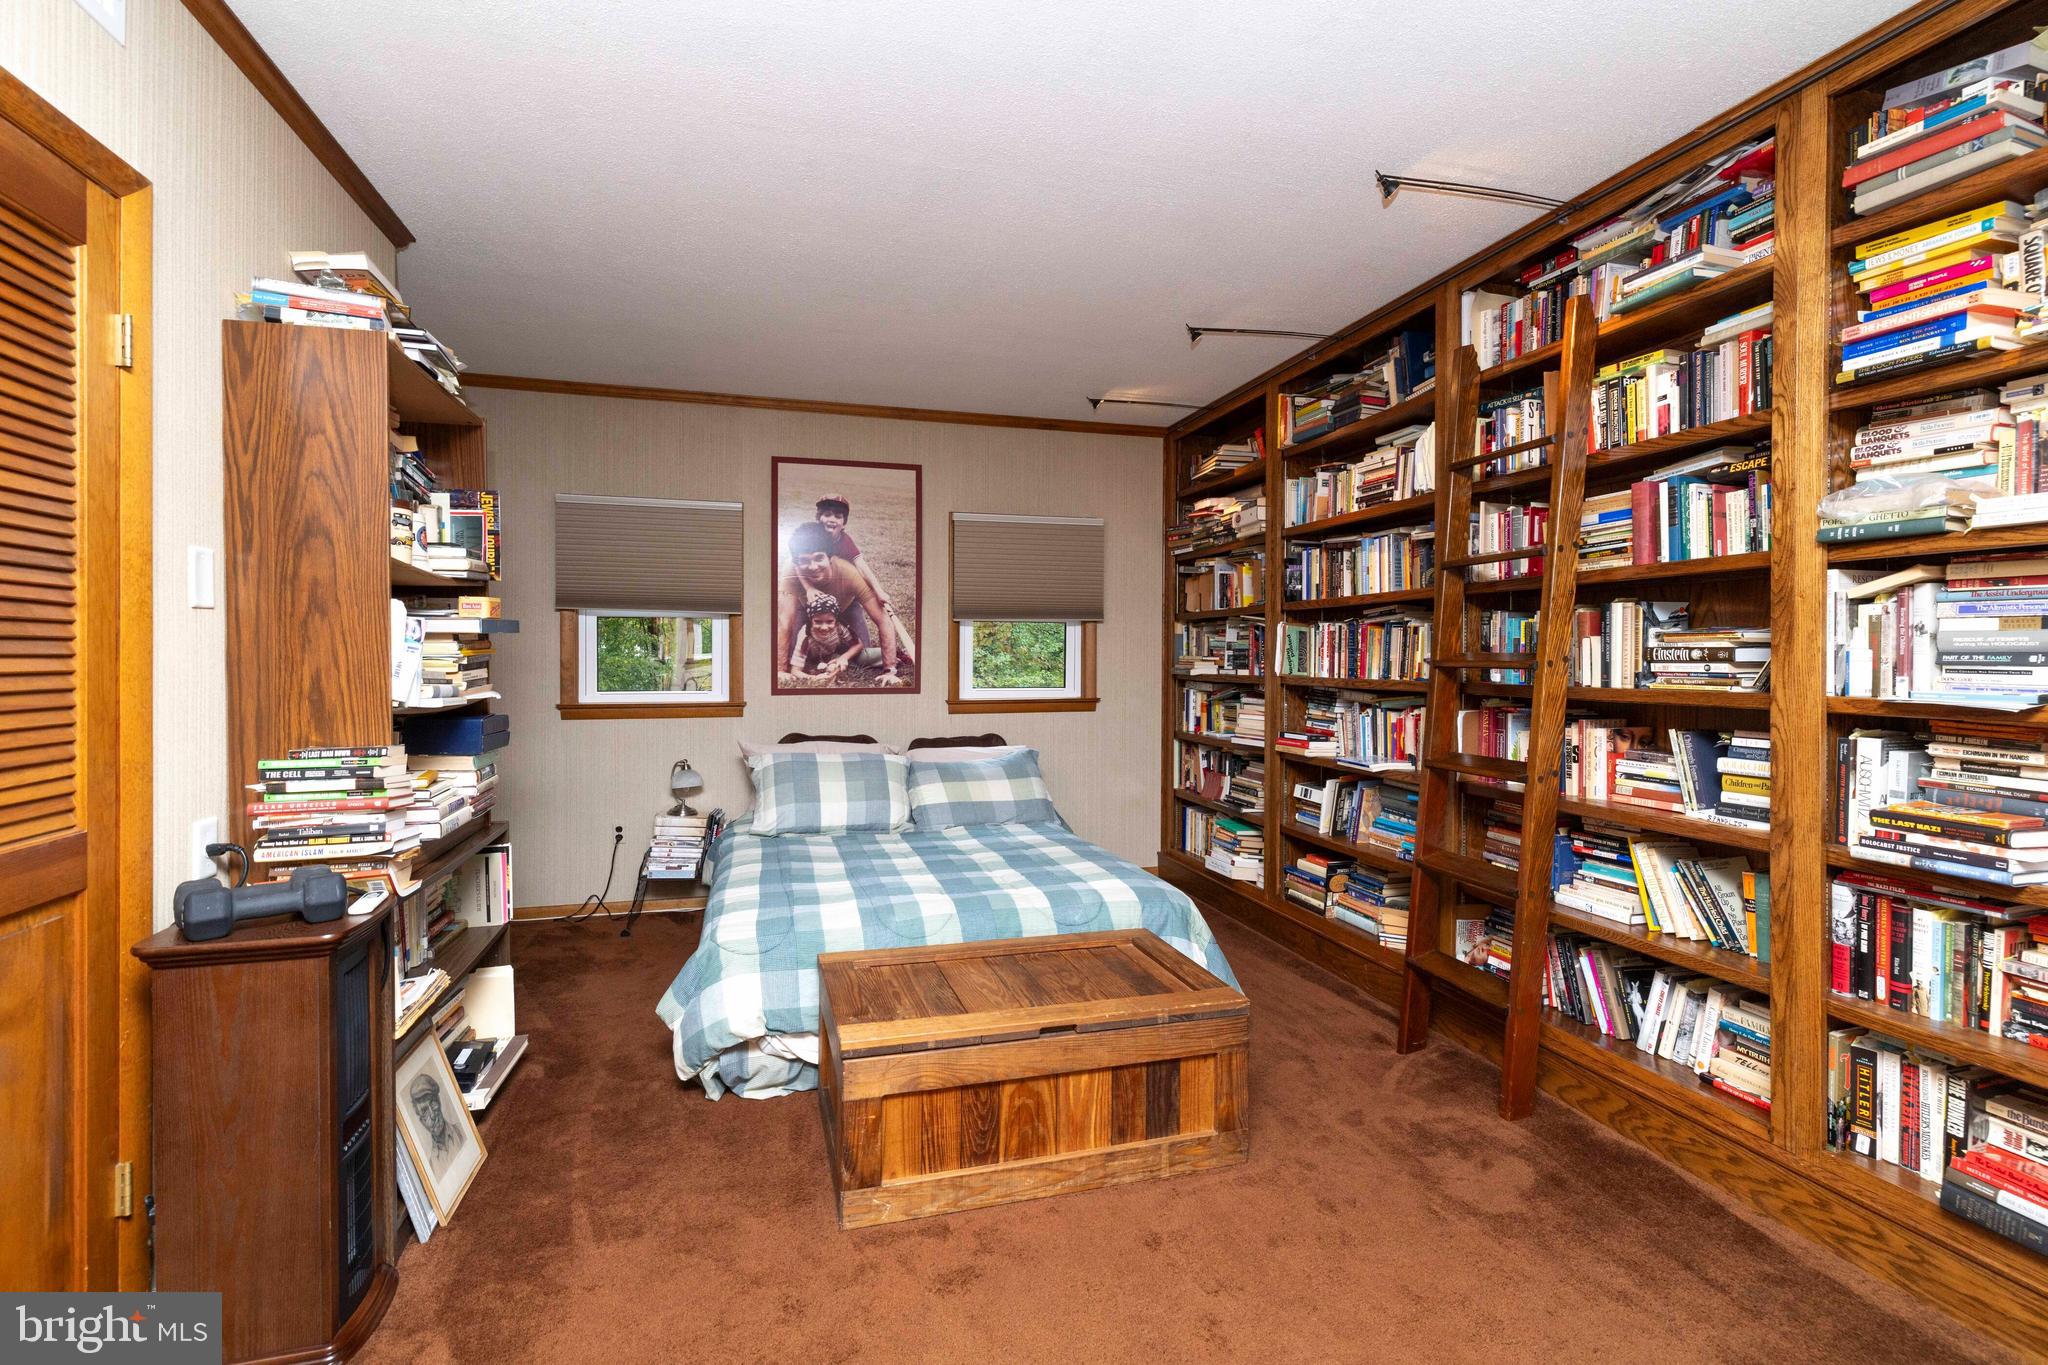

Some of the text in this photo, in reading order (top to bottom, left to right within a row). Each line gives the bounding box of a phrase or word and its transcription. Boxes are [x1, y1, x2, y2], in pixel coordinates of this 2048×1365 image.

[2023, 236, 2042, 284] SQUARE
[1739, 341, 1748, 385] SOUL MURDER
[1860, 431, 1910, 445] BANQUETS
[1861, 428, 1892, 438] BLOOD
[1854, 443, 1885, 453] BLOOD
[1854, 447, 1902, 461] BANQUETS
[1729, 457, 1768, 473] ESCAPE
[1868, 511, 1909, 522] GHETTO
[1652, 647, 1690, 661] Einstein
[308, 750, 320, 758] LAST
[334, 749, 351, 757] DOWN
[1962, 749, 1991, 758] EICHMANN
[2009, 753, 2030, 761] HANDS
[282, 770, 301, 778] CELL
[1725, 777, 1753, 788] Children
[1857, 754, 1872, 818] AUSCHWITZ
[1966, 786, 1996, 794] EICHMANN
[254, 801, 337, 811] ISLAM UNVEILED
[1872, 816, 1890, 825] THE
[1891, 818, 1916, 830] LAST
[1916, 824, 1942, 833] NAZI
[296, 828, 323, 836] Taliban
[1861, 837, 1921, 854] HOLOCAUST JUSTICE
[261, 849, 324, 859] AMERICAN ISLAM
[1698, 886, 1729, 935] The Hurried Child
[1737, 1045, 1748, 1054] MY
[1735, 1056, 1758, 1071] TELL
[1858, 1067, 1871, 1118] HITLER
[1946, 1074, 1966, 1138] THE BUNKER
[2007, 1109, 2021, 1122] the
[1921, 1129, 1930, 1161] MISTAKES
